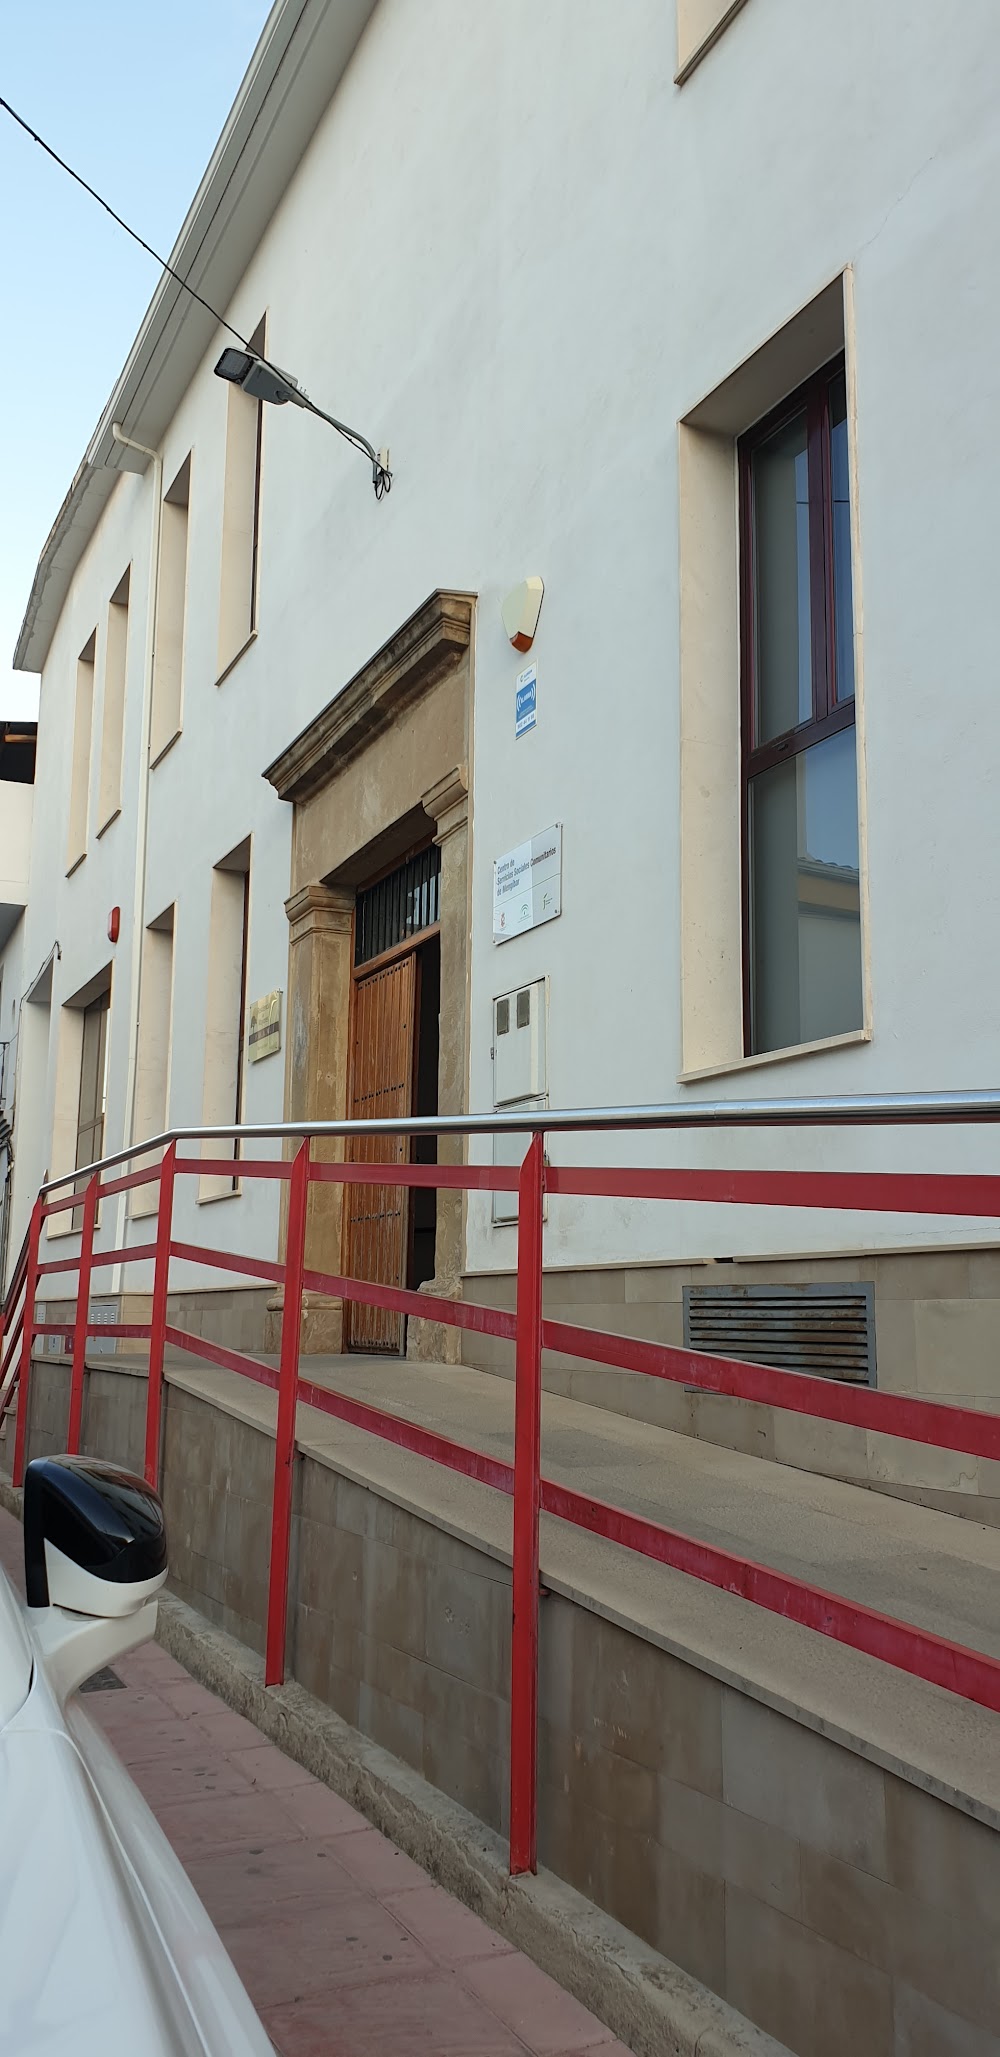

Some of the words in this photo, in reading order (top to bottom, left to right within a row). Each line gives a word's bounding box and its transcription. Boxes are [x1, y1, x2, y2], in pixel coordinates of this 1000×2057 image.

[496, 871, 513, 885] Servicios
[514, 862, 529, 876] Sociales
[530, 847, 556, 867] Comunitarios
[497, 863, 509, 874] Centro
[510, 859, 514, 868] de
